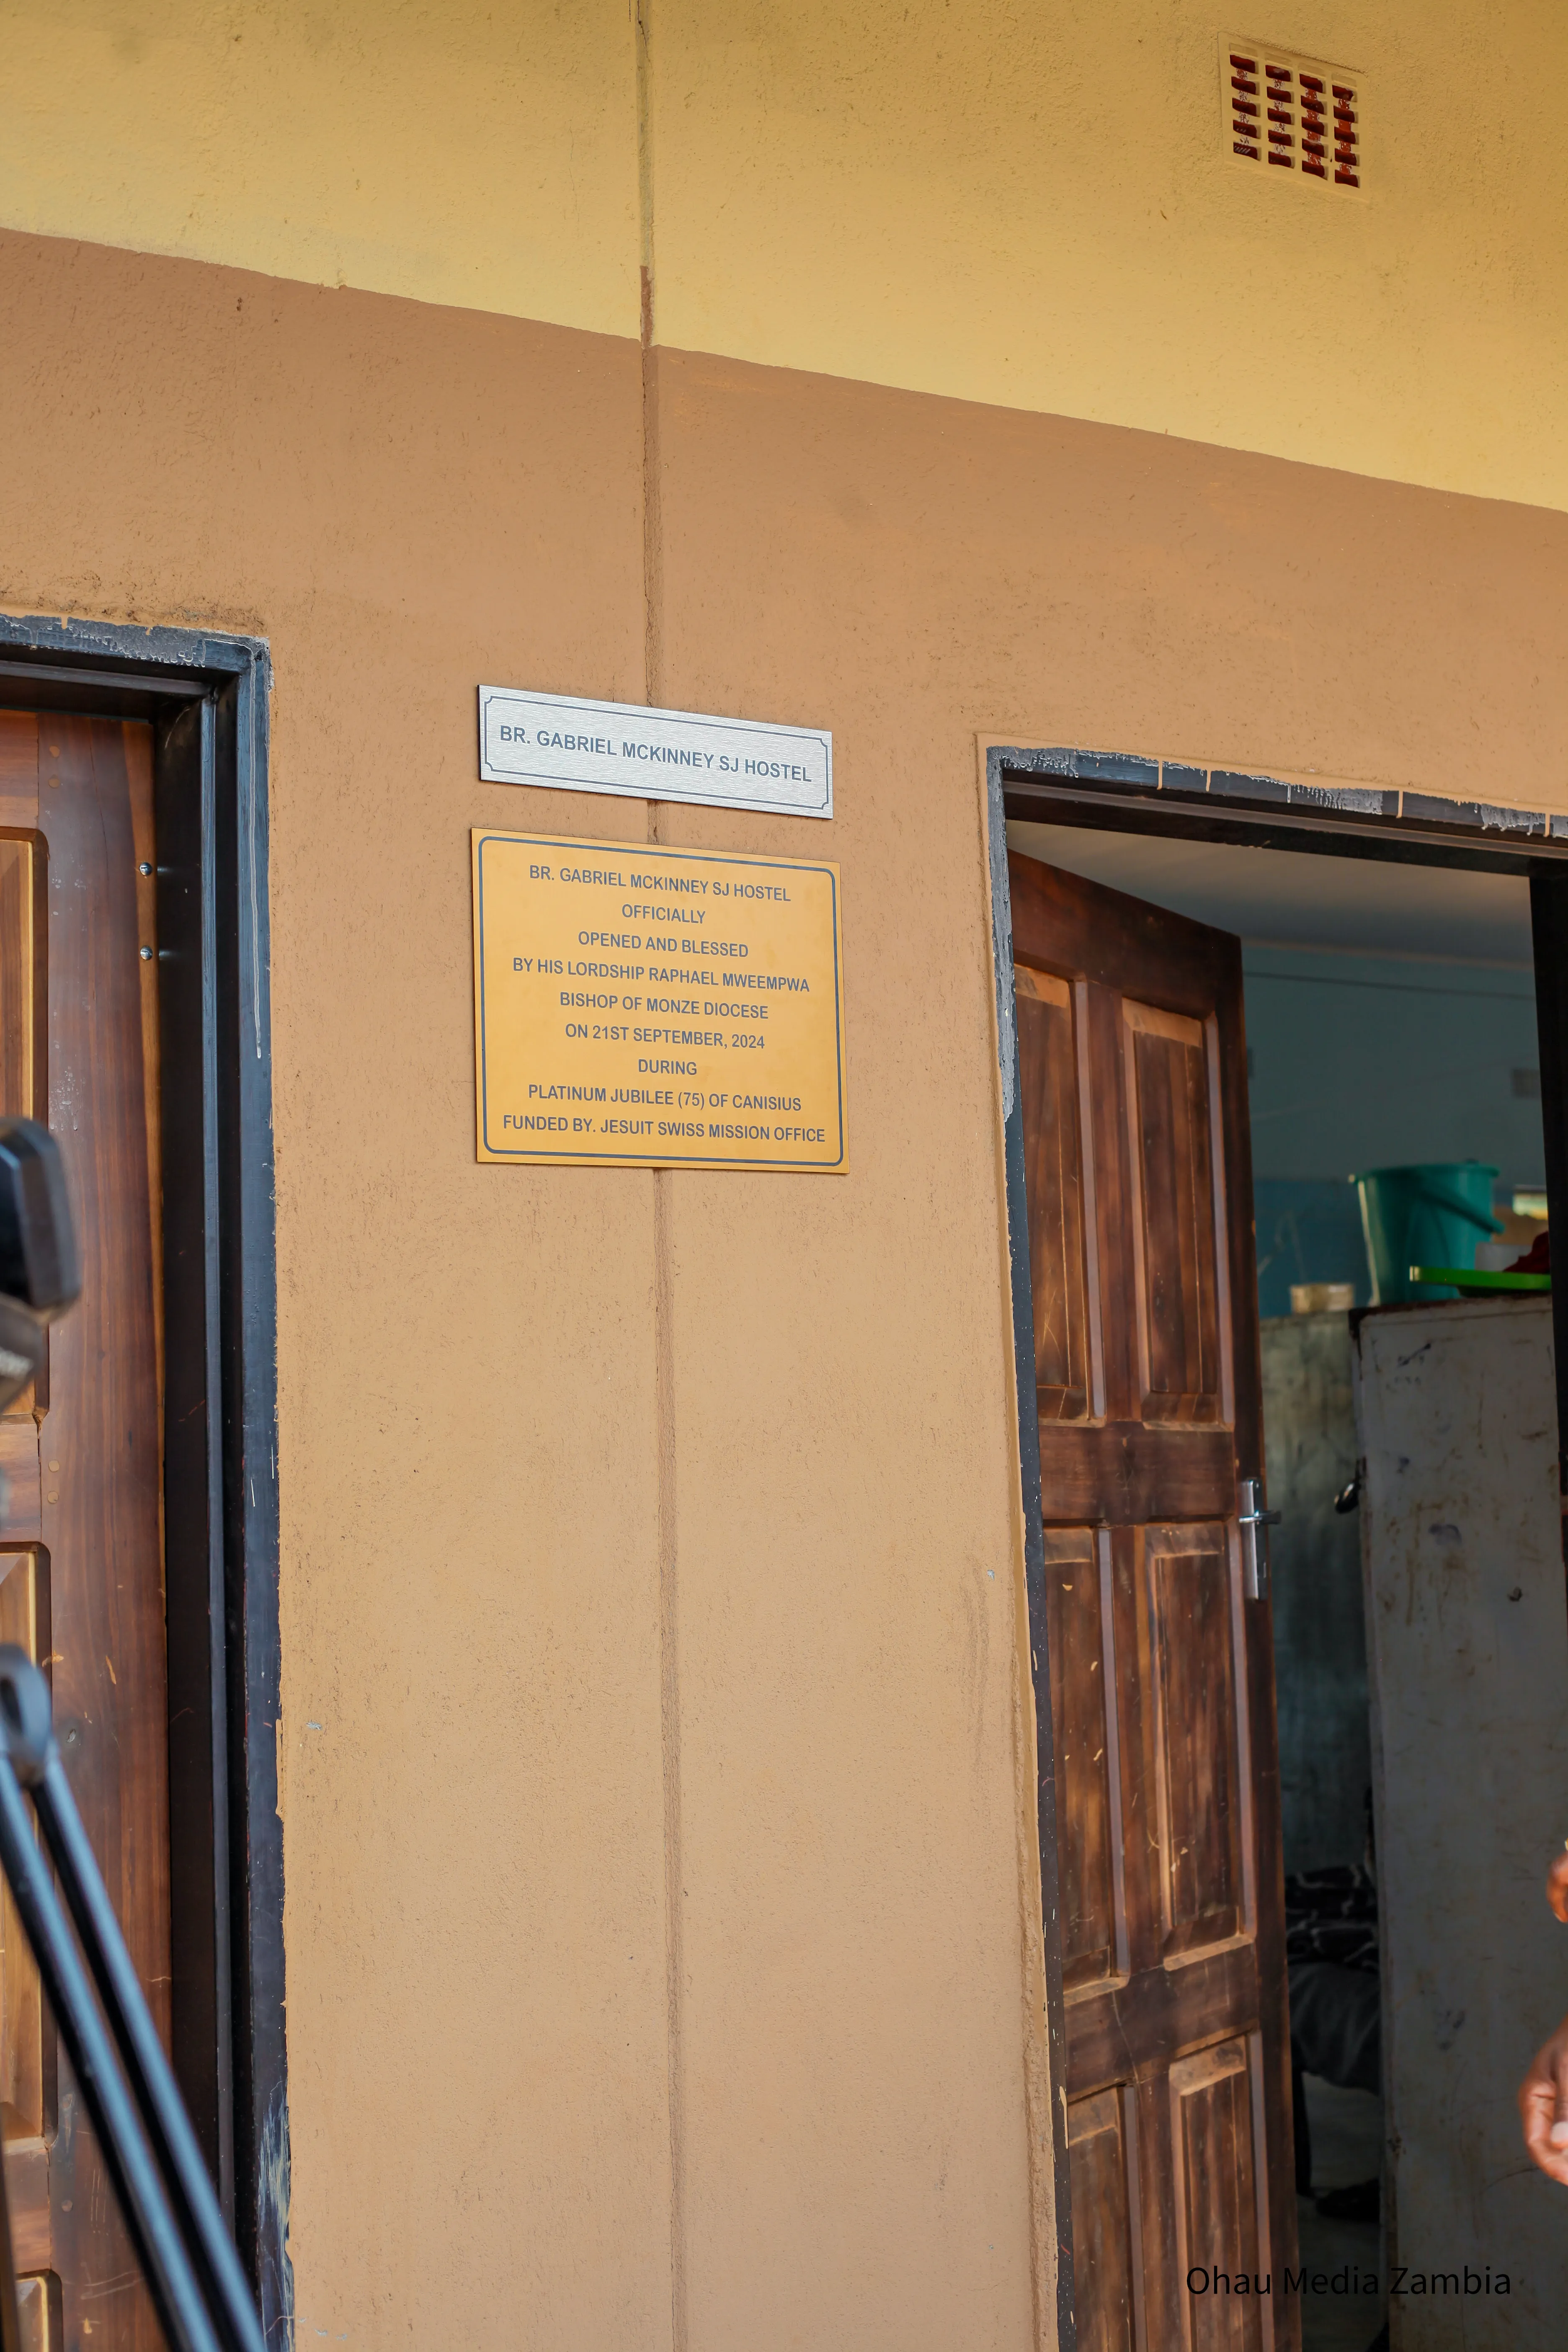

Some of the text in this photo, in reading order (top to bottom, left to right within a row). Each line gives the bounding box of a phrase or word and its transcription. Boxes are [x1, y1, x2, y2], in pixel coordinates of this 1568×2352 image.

[500, 725, 812, 782] BR. GABRIEL MCKINNEY SJ HOSTEL
[529, 864, 791, 902] BR. GABRIEL MCKINNEY SJ HOSTEL
[622, 903, 706, 923] OFFICIALLY
[578, 931, 748, 957] OPENED AND BLESSED
[513, 957, 810, 992] BY HIS LORDSHIP RAPHAEL MWEEMPWA
[560, 991, 768, 1019] BISHOP OF MONZE DIOCESE
[565, 1023, 764, 1049] ON 21ST SEPTEMBER, 2024
[638, 1058, 697, 1075] DURING
[529, 1084, 801, 1111] PLATINUM JUBILEE (75) OF CANISIUS
[503, 1114, 825, 1142] FUNDED BY. JESUIT SWISS MISSION OFFICE
